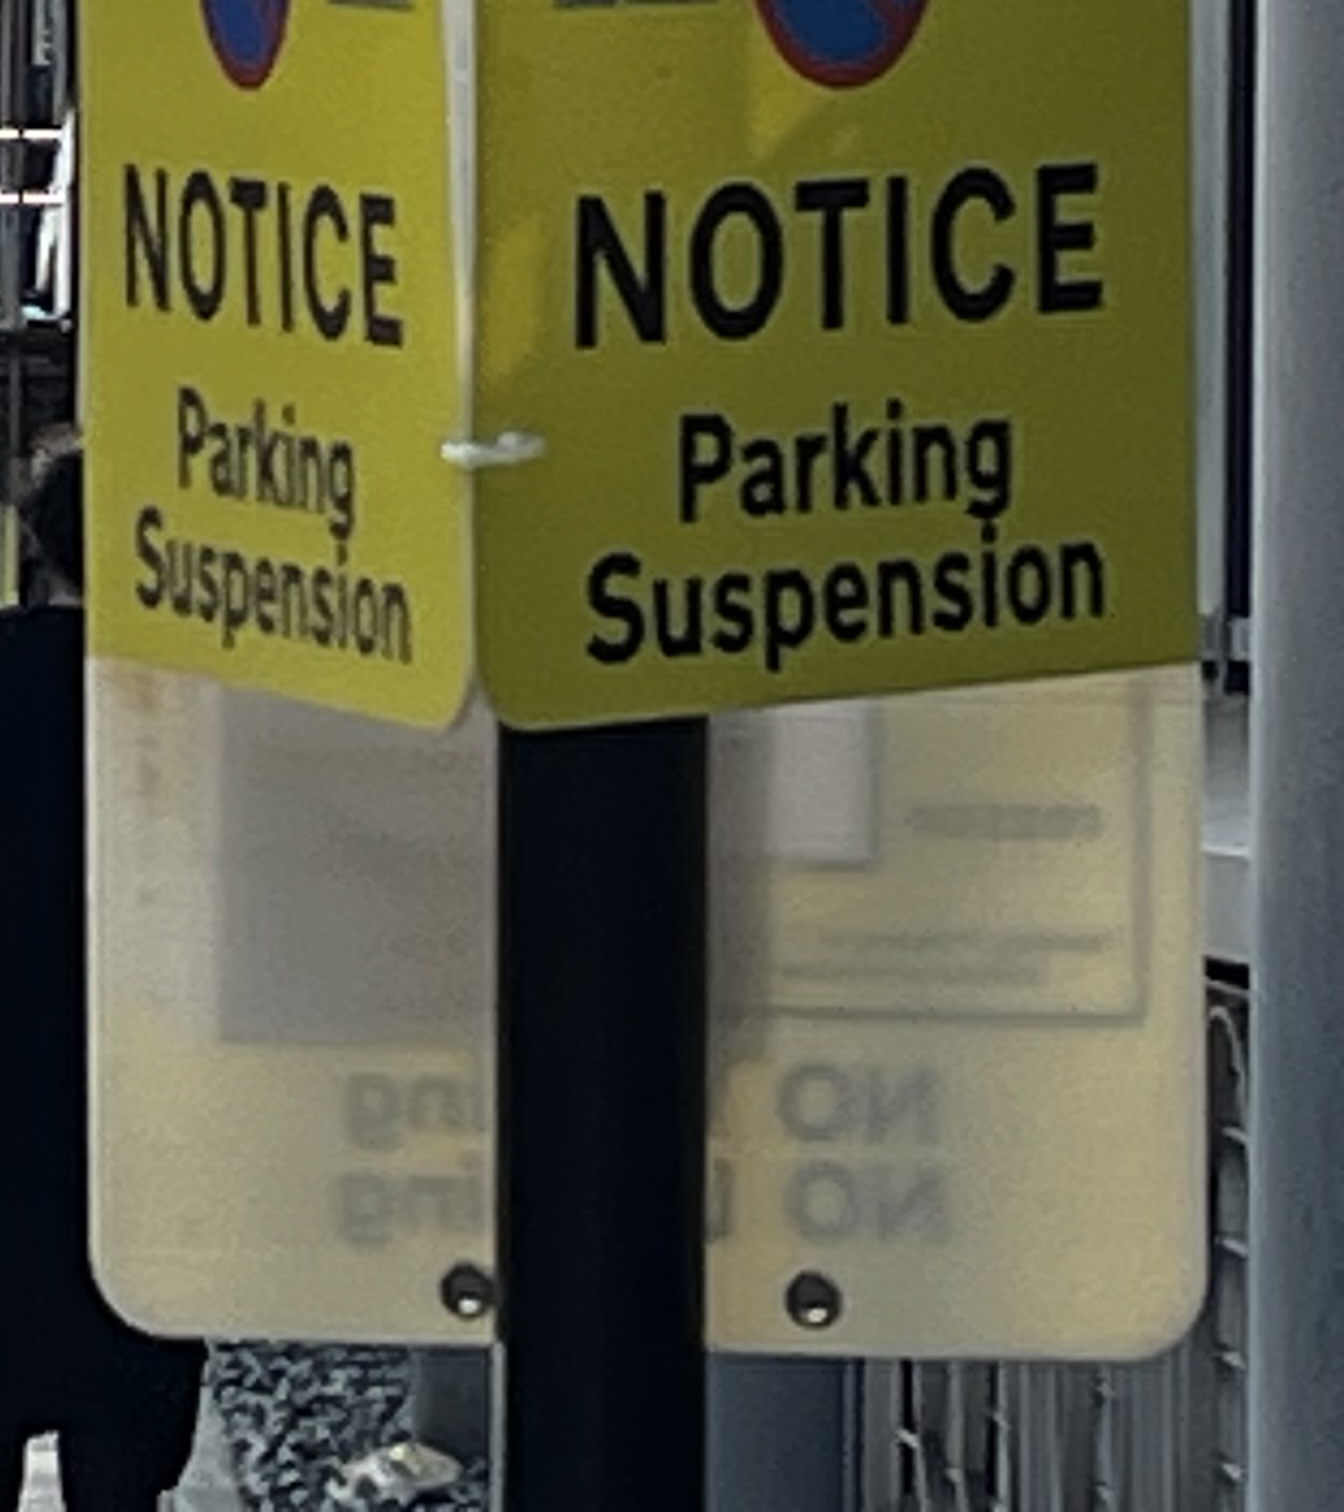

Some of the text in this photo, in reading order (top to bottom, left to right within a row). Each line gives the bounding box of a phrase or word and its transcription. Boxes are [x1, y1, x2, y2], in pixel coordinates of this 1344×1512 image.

[124, 164, 403, 348] NOTICE
[574, 162, 1105, 351] NOTICE
[178, 386, 355, 539] Parking
[678, 396, 1013, 524] Parking
[136, 506, 413, 663] Suspension
[586, 526, 1105, 675] Suspension
